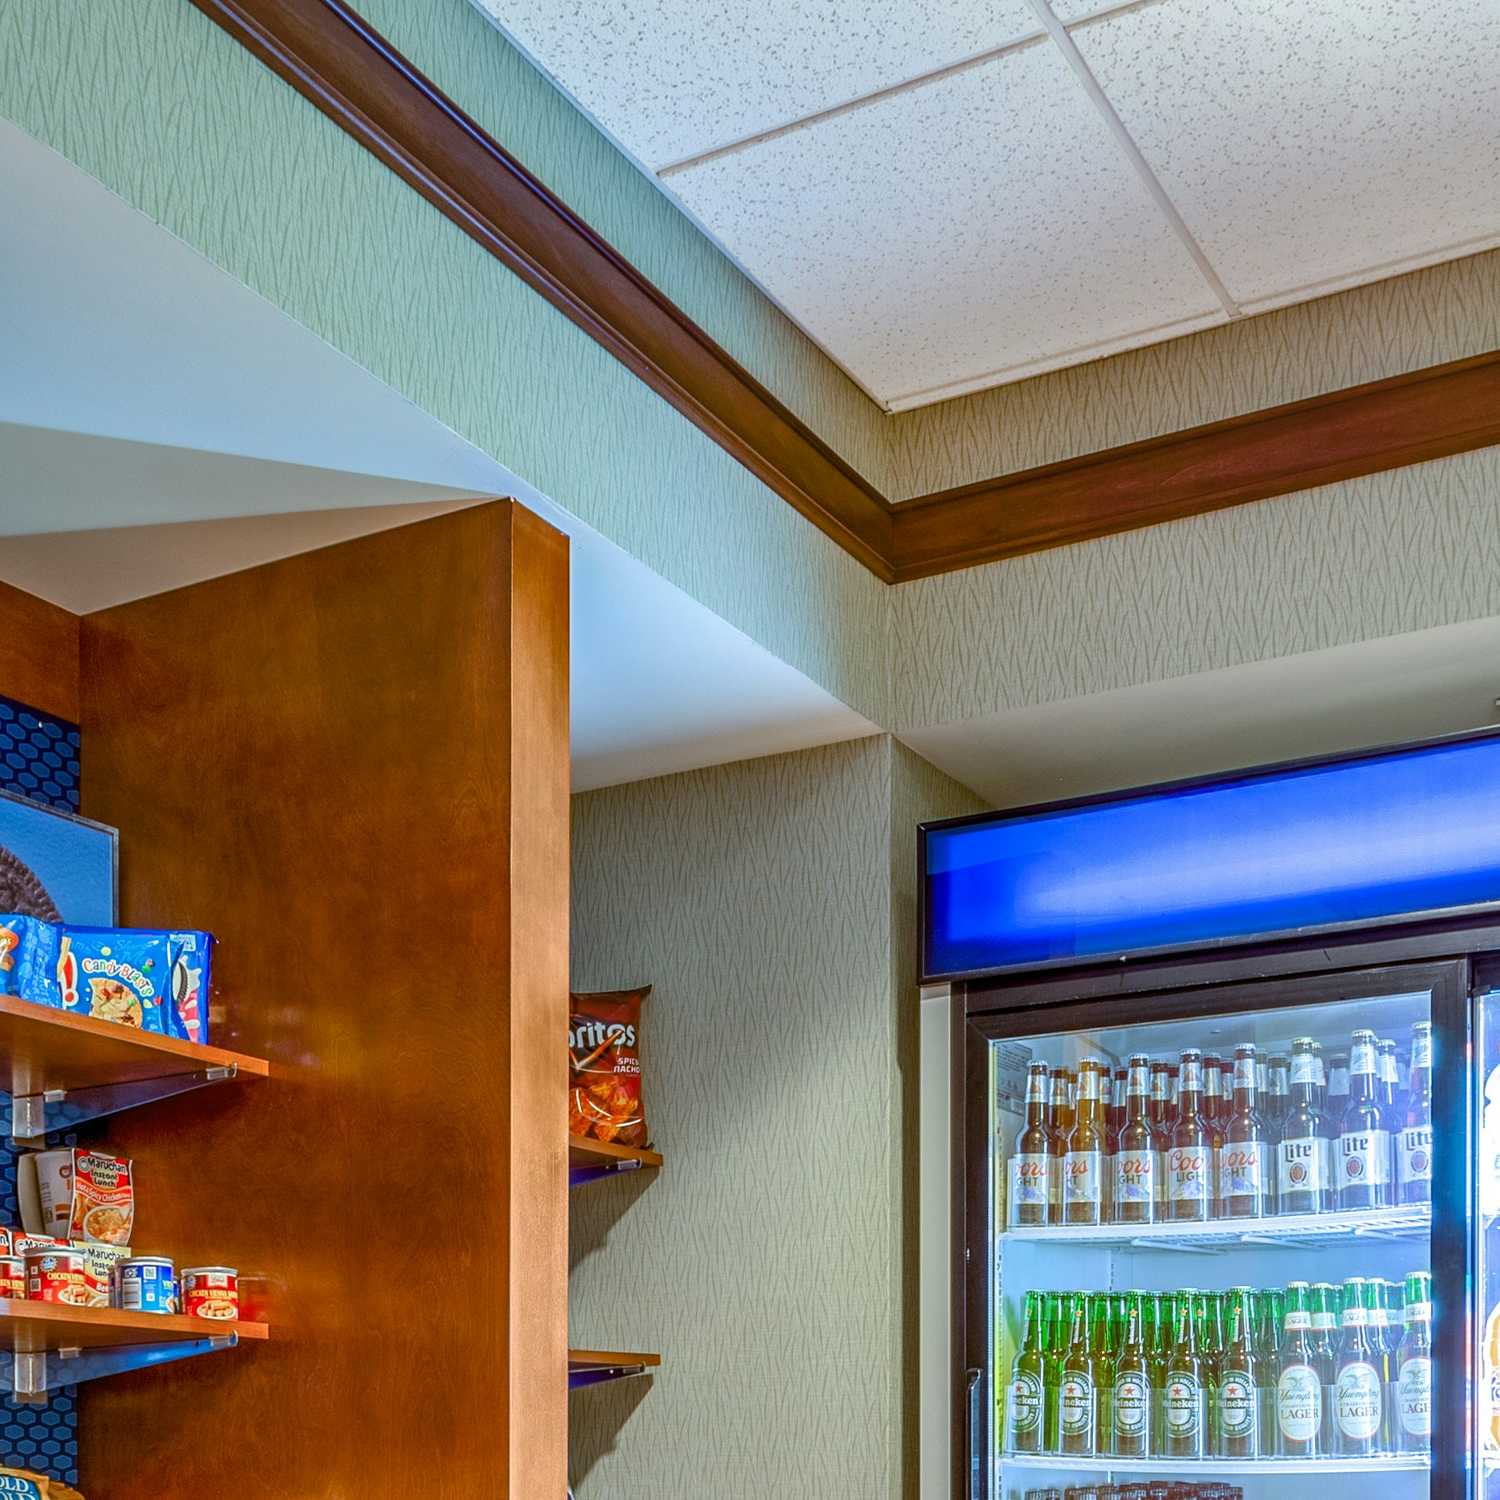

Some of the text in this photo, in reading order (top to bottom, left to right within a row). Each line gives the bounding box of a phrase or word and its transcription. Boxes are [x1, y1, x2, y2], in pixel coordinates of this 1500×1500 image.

[1284, 1143, 1313, 1163] Lite
[1341, 1136, 1369, 1157] Lite
[88, 1157, 127, 1174] Maruchan
[91, 1169, 117, 1181] Instant
[94, 1178, 116, 1188] Lunch
[1279, 1388, 1321, 1403] Yuengling
[1338, 1386, 1380, 1401] Yuengling
[1280, 1408, 1320, 1420] LAGER
[1339, 1406, 1379, 1418] LAGER
